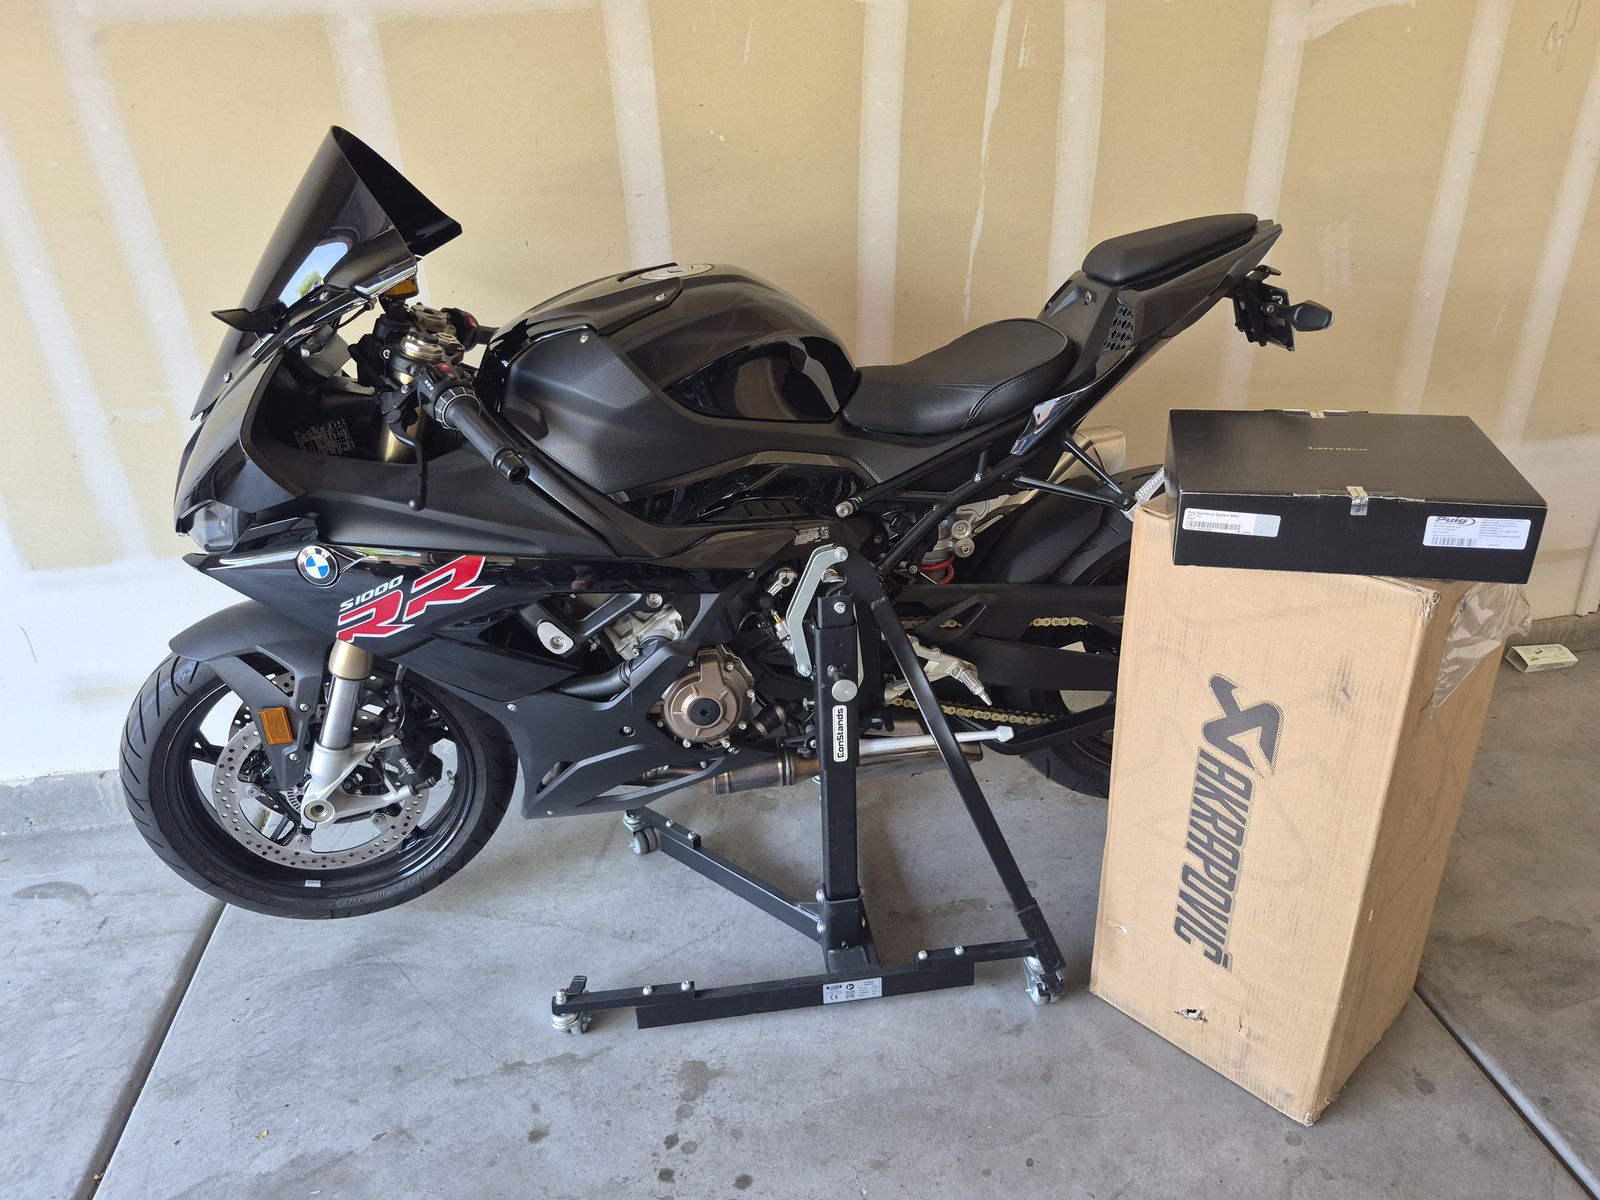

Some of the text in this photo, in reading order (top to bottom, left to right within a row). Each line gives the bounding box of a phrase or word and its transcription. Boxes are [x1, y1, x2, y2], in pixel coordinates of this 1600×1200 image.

[1435, 516, 1468, 525] Puig
[336, 555, 496, 643] RR
[339, 574, 404, 613] S1000
[399, 757, 415, 775] BMW
